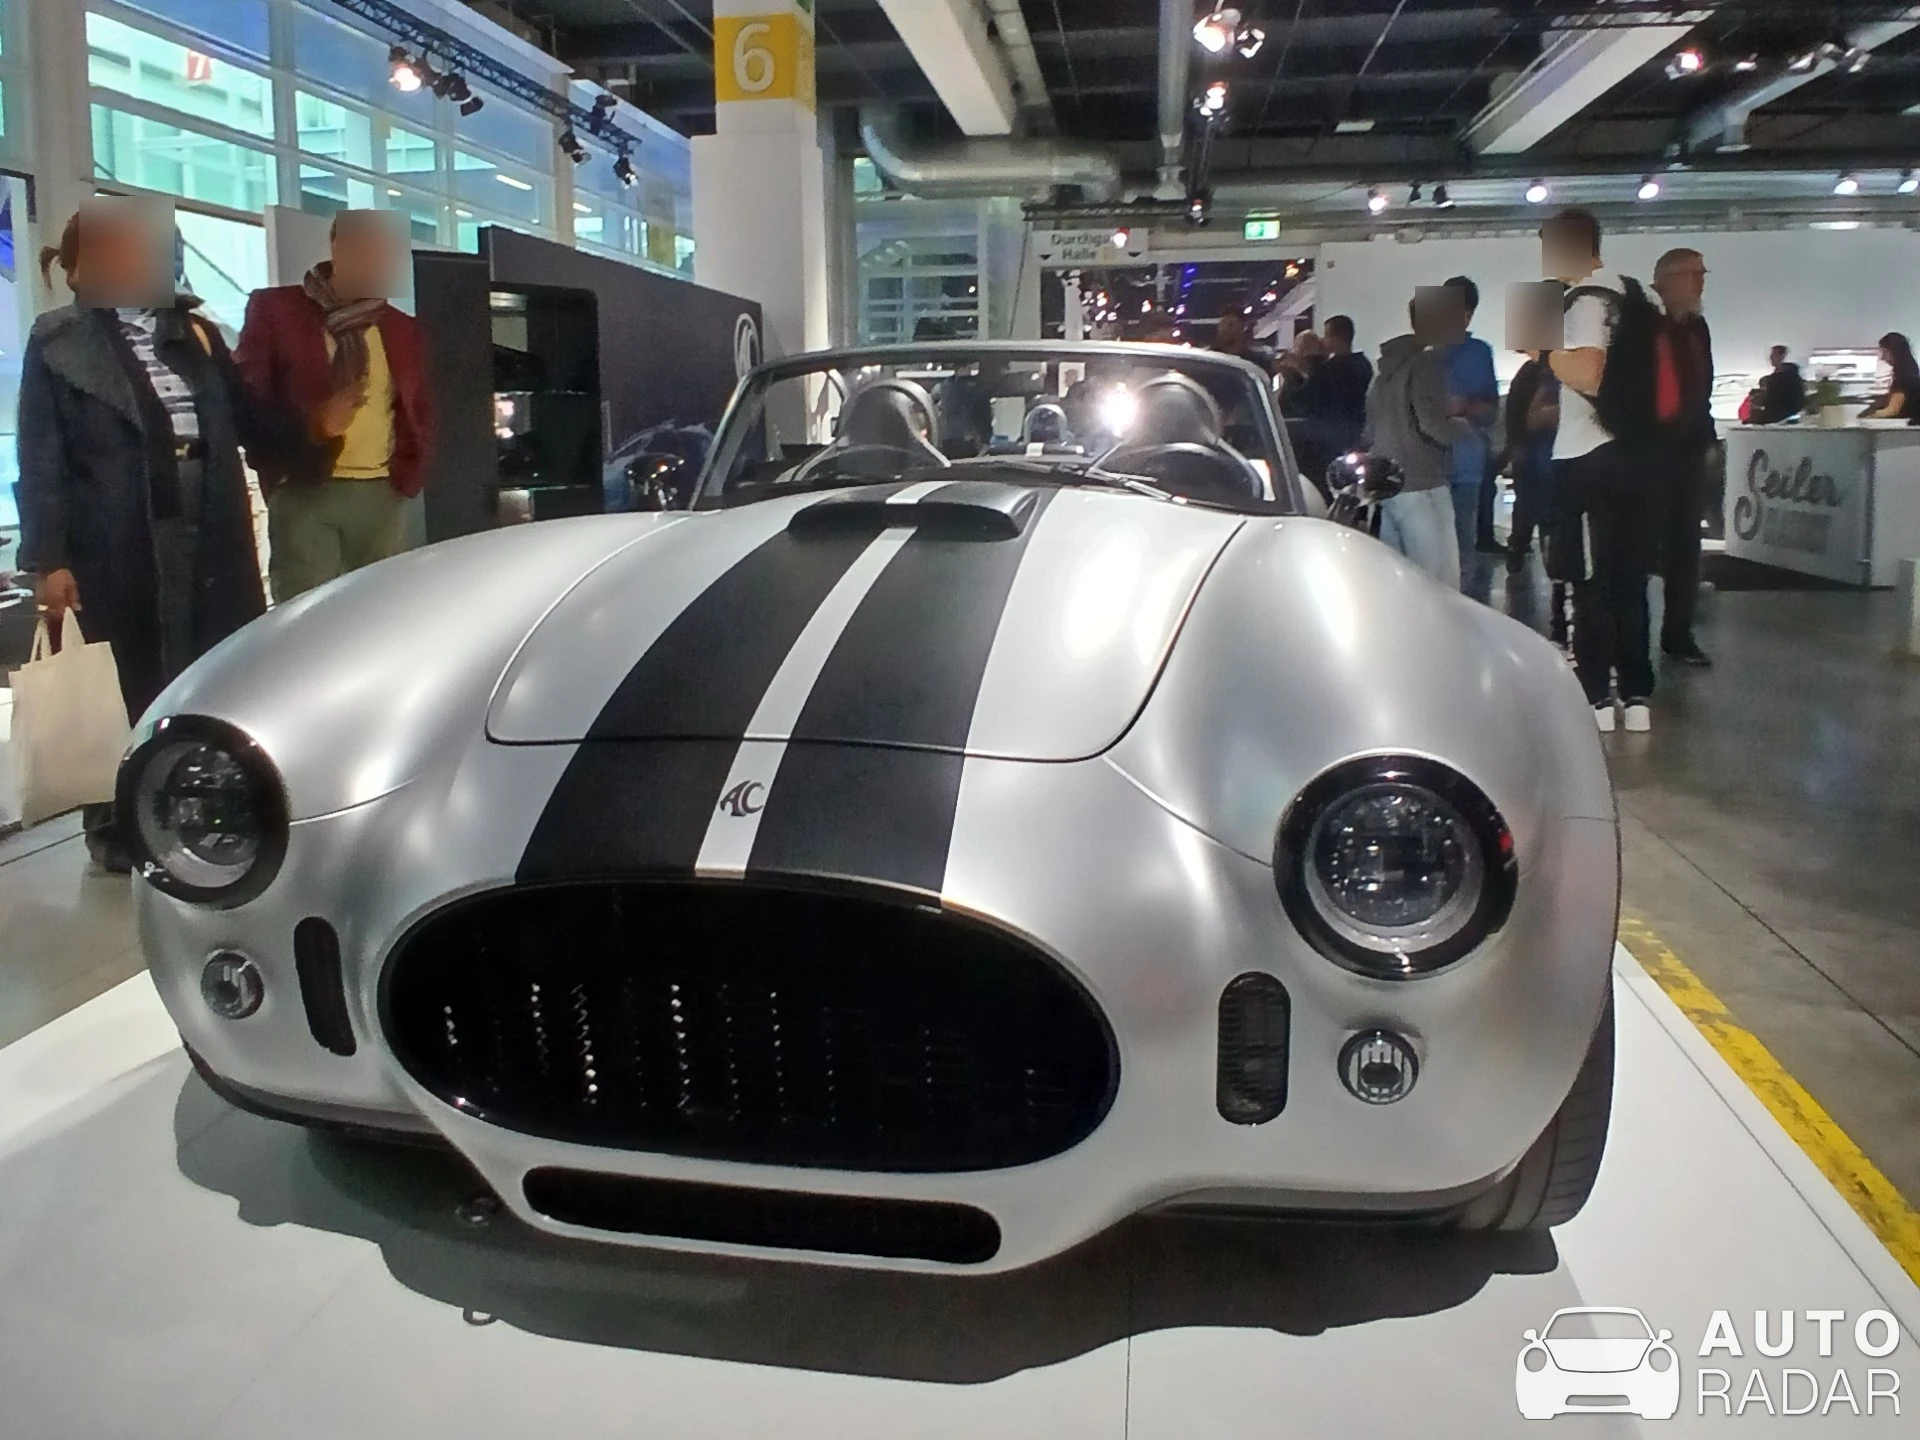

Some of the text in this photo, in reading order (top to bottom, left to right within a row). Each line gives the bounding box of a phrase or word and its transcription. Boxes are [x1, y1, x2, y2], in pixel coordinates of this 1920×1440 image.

[734, 23, 774, 92] 6
[1051, 233, 1127, 247] Durchga
[720, 780, 765, 817] AC
